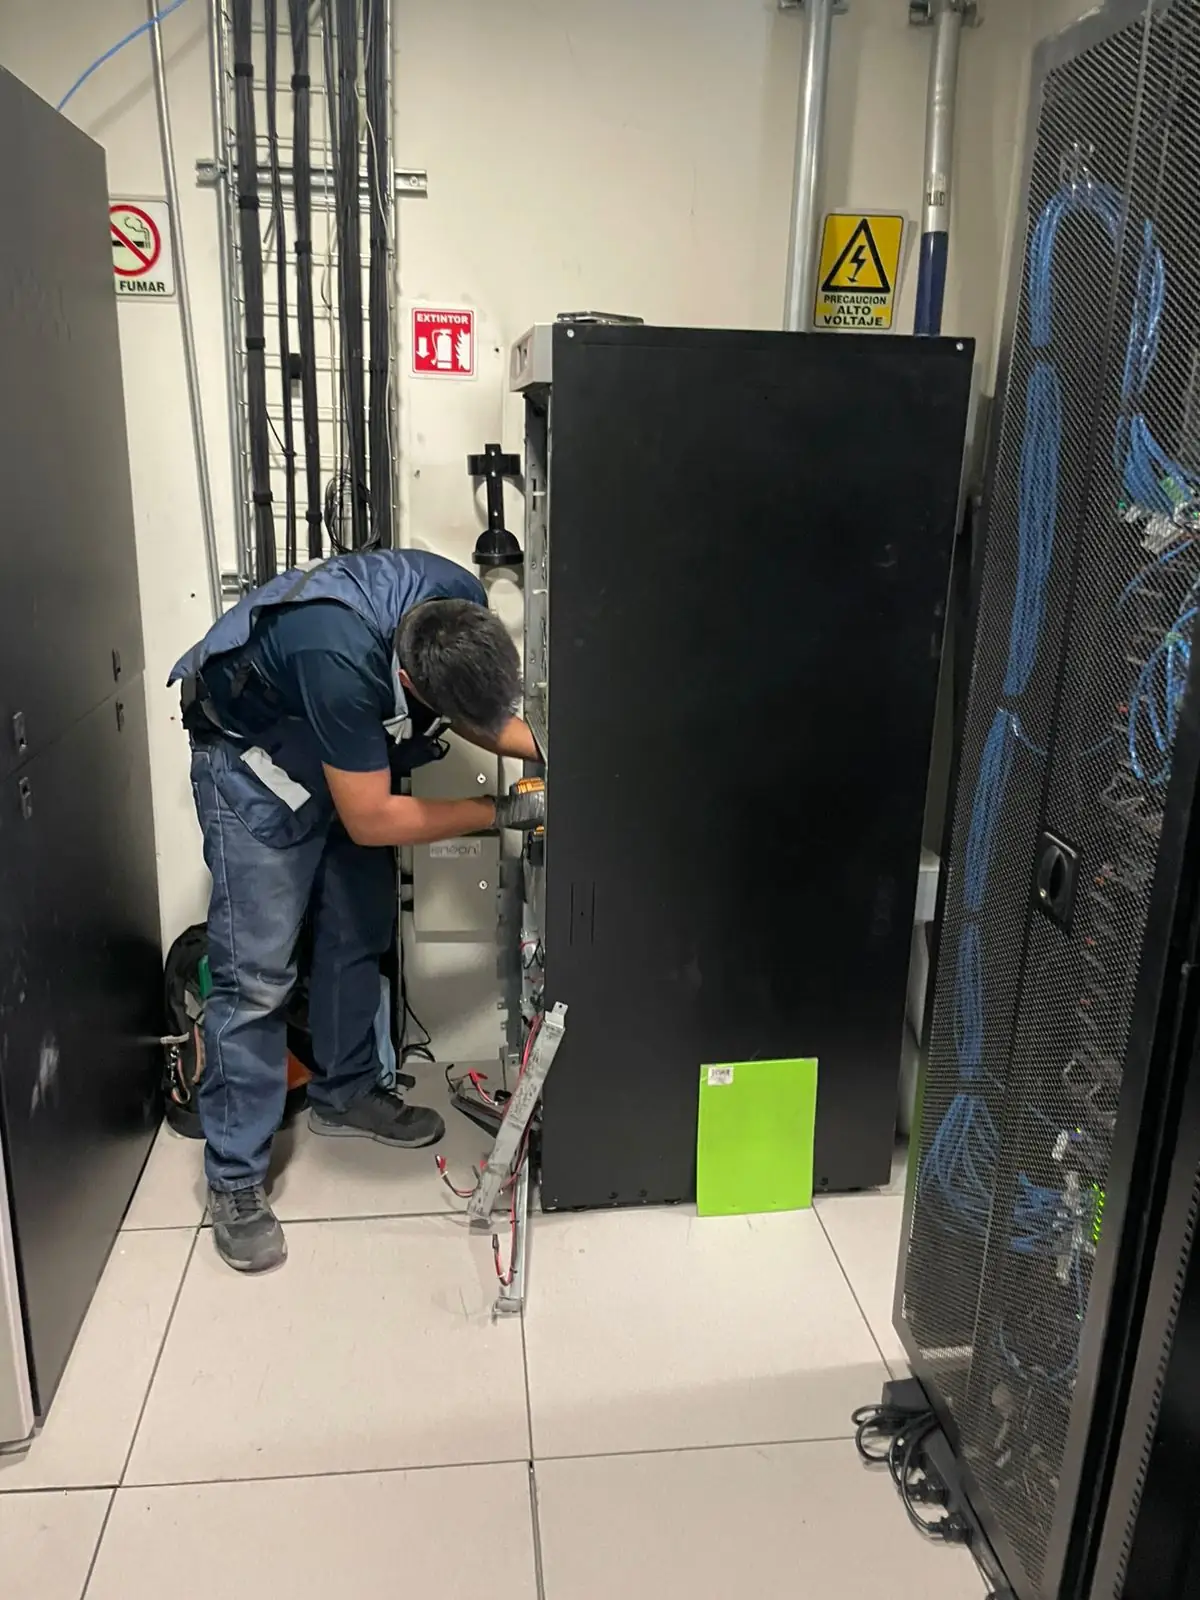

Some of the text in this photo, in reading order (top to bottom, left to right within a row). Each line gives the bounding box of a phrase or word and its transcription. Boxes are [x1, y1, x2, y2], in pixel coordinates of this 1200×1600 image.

[120, 280, 165, 292] FUMAR
[824, 295, 887, 305] PRECAUCION
[837, 306, 871, 315] ALTO
[416, 313, 469, 324] EXTINTOR
[824, 316, 883, 326] VOLTAJE
